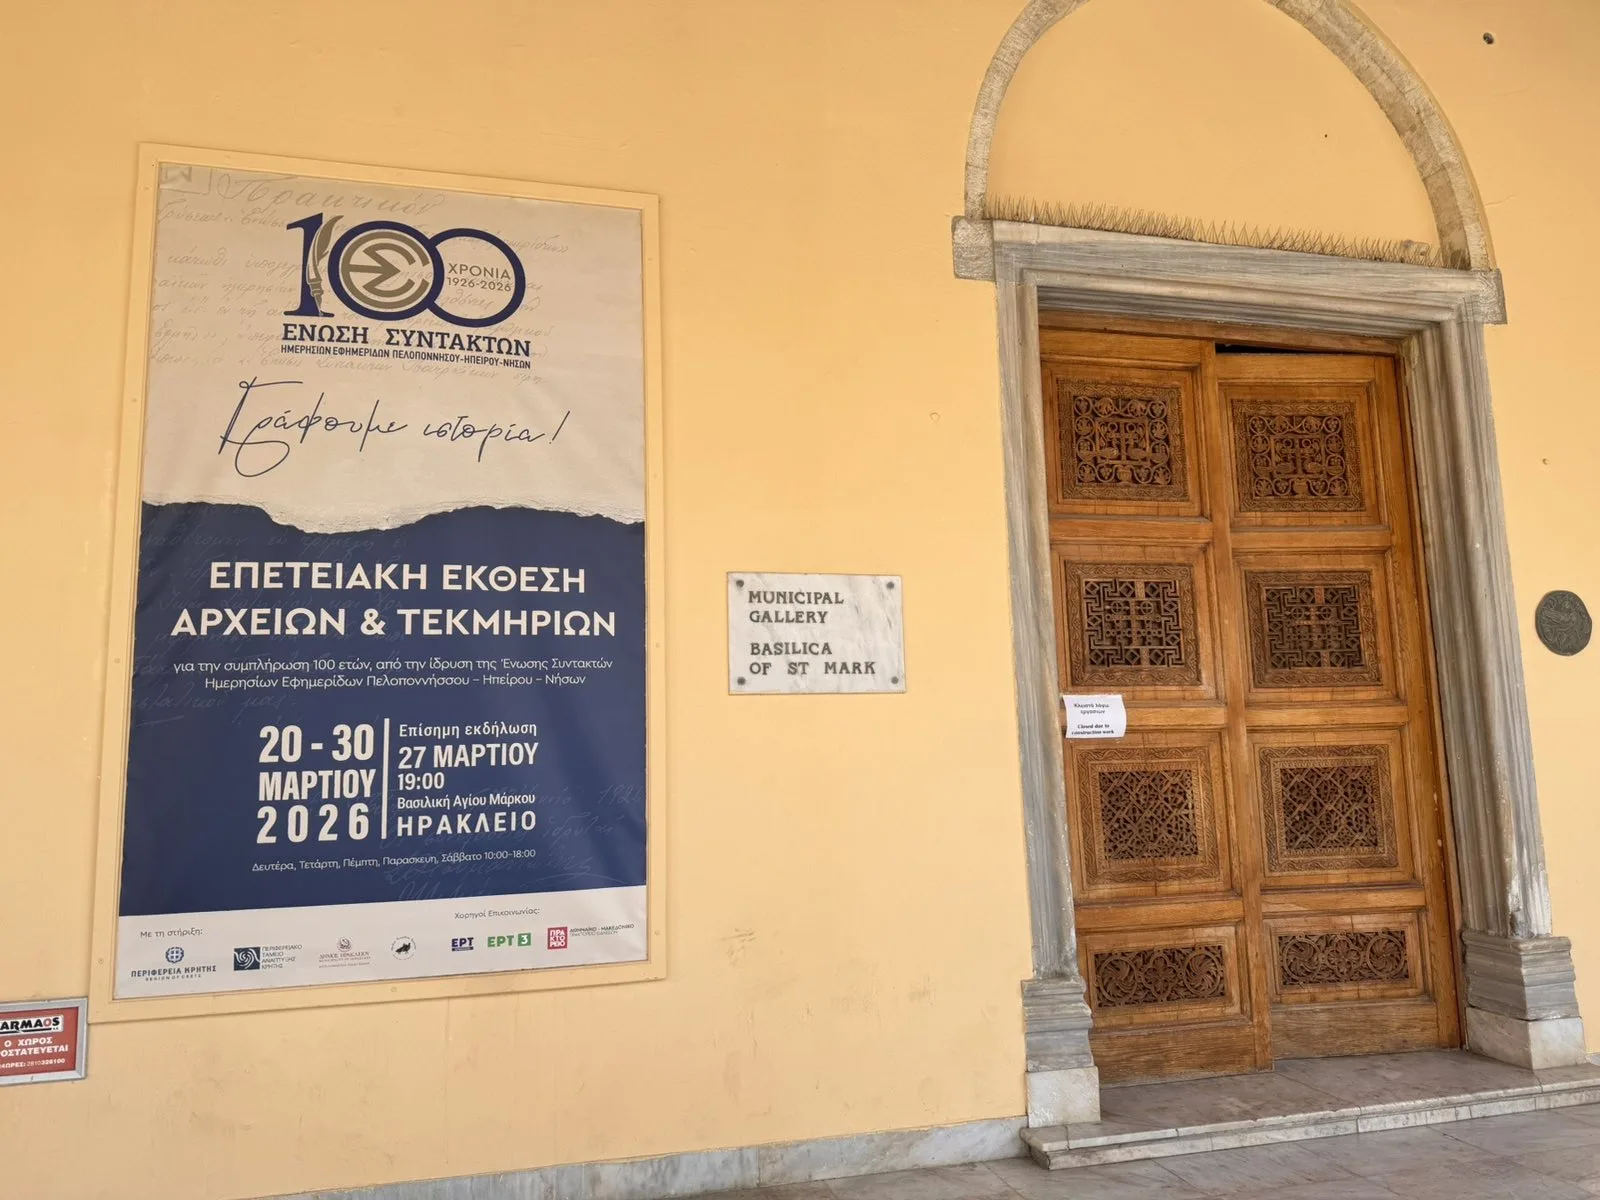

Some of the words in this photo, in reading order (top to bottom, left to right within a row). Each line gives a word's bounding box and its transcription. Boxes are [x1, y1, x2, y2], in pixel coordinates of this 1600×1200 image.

[447, 262, 512, 281] ΧΡΟΝΙΑ
[446, 276, 512, 293] 1926-2026
[282, 323, 369, 344] ΕΝΩΣΗ
[385, 328, 531, 357] ΣΥΝΤΑΚΤΩΝ
[281, 345, 331, 355] ΗΜΕΡΗΣΙΩΝ
[332, 347, 390, 358] ΕΦΗΜΕΡΙΔΩΝ
[392, 350, 531, 370] ΠΕΛΟΠΟΝΝΗΣΟΥ-ΗΠΕΙΡΟΥ-ΝΗΣΩΝ
[210, 561, 427, 590] ΕΠΕΤΕΙΑΚΗ
[442, 564, 585, 593] ΕΚΘΕΣΗ
[748, 590, 845, 605] MUNICIPAL
[170, 607, 346, 636] ΑΡΧΕΙΩΝ
[360, 608, 386, 636] &
[397, 608, 616, 637] ΤΕΚΜΗΡΙΩΝ
[749, 610, 829, 624] GALLERY
[750, 642, 833, 656] BASILICA
[173, 662, 195, 673] για
[198, 661, 220, 673] την
[224, 658, 310, 673] συμπλήρωση
[312, 659, 335, 670] 100
[338, 658, 373, 671] ετών,
[376, 657, 401, 670] από
[405, 660, 426, 671] την
[429, 656, 473, 671] ίδρυση
[475, 660, 497, 671] της
[501, 657, 548, 671] Ένωσης
[551, 657, 613, 669] Συντακτών
[749, 662, 772, 675] OF
[787, 661, 810, 675] ST
[823, 661, 876, 675] MARK
[205, 675, 278, 690] Ημερησίων
[282, 674, 363, 689] Εφημερίδων
[366, 673, 470, 688] Πελοποννήσσου
[483, 673, 533, 687] Ηπείρου
[545, 672, 586, 686] Νήσων
[399, 723, 460, 739] Επίσημη
[465, 721, 537, 738] εκδήλωση
[259, 725, 302, 763] 20
[331, 724, 375, 761] 30
[398, 746, 427, 769] 27
[433, 742, 539, 768] ΜΑΡΤΙΟΥ
[258, 769, 376, 801] ΜΑΡΤΙΟΥ
[397, 772, 445, 791] 19:00
[397, 794, 450, 810] Βασιλική
[453, 793, 487, 810] Αγίου
[489, 791, 536, 807] Μάρκου
[256, 803, 370, 844] 2026
[397, 810, 537, 837] ΗΡΑΚΛΕΙΟ
[252, 860, 297, 872] Δευτέρα,
[299, 858, 341, 870] Τετάρτη,
[343, 857, 381, 868] Πέμπτη,
[441, 852, 482, 863] Σάββατο
[454, 909, 487, 920] Χορηγοί
[488, 907, 540, 918] Επικοινωνίας:
[154, 930, 165, 938] τη
[167, 927, 203, 938] στήριξη:
[487, 935, 514, 948] ΕΡΤ
[520, 934, 529, 945] 3
[451, 937, 474, 948] ΕΡΤ
[131, 967, 182, 977] ΠΕΡΙΦΕΡΕΙΑ
[184, 965, 217, 974] ΚΡΗΤΗΣ
[17, 1037, 53, 1046] ΧΩΡΟΣ
